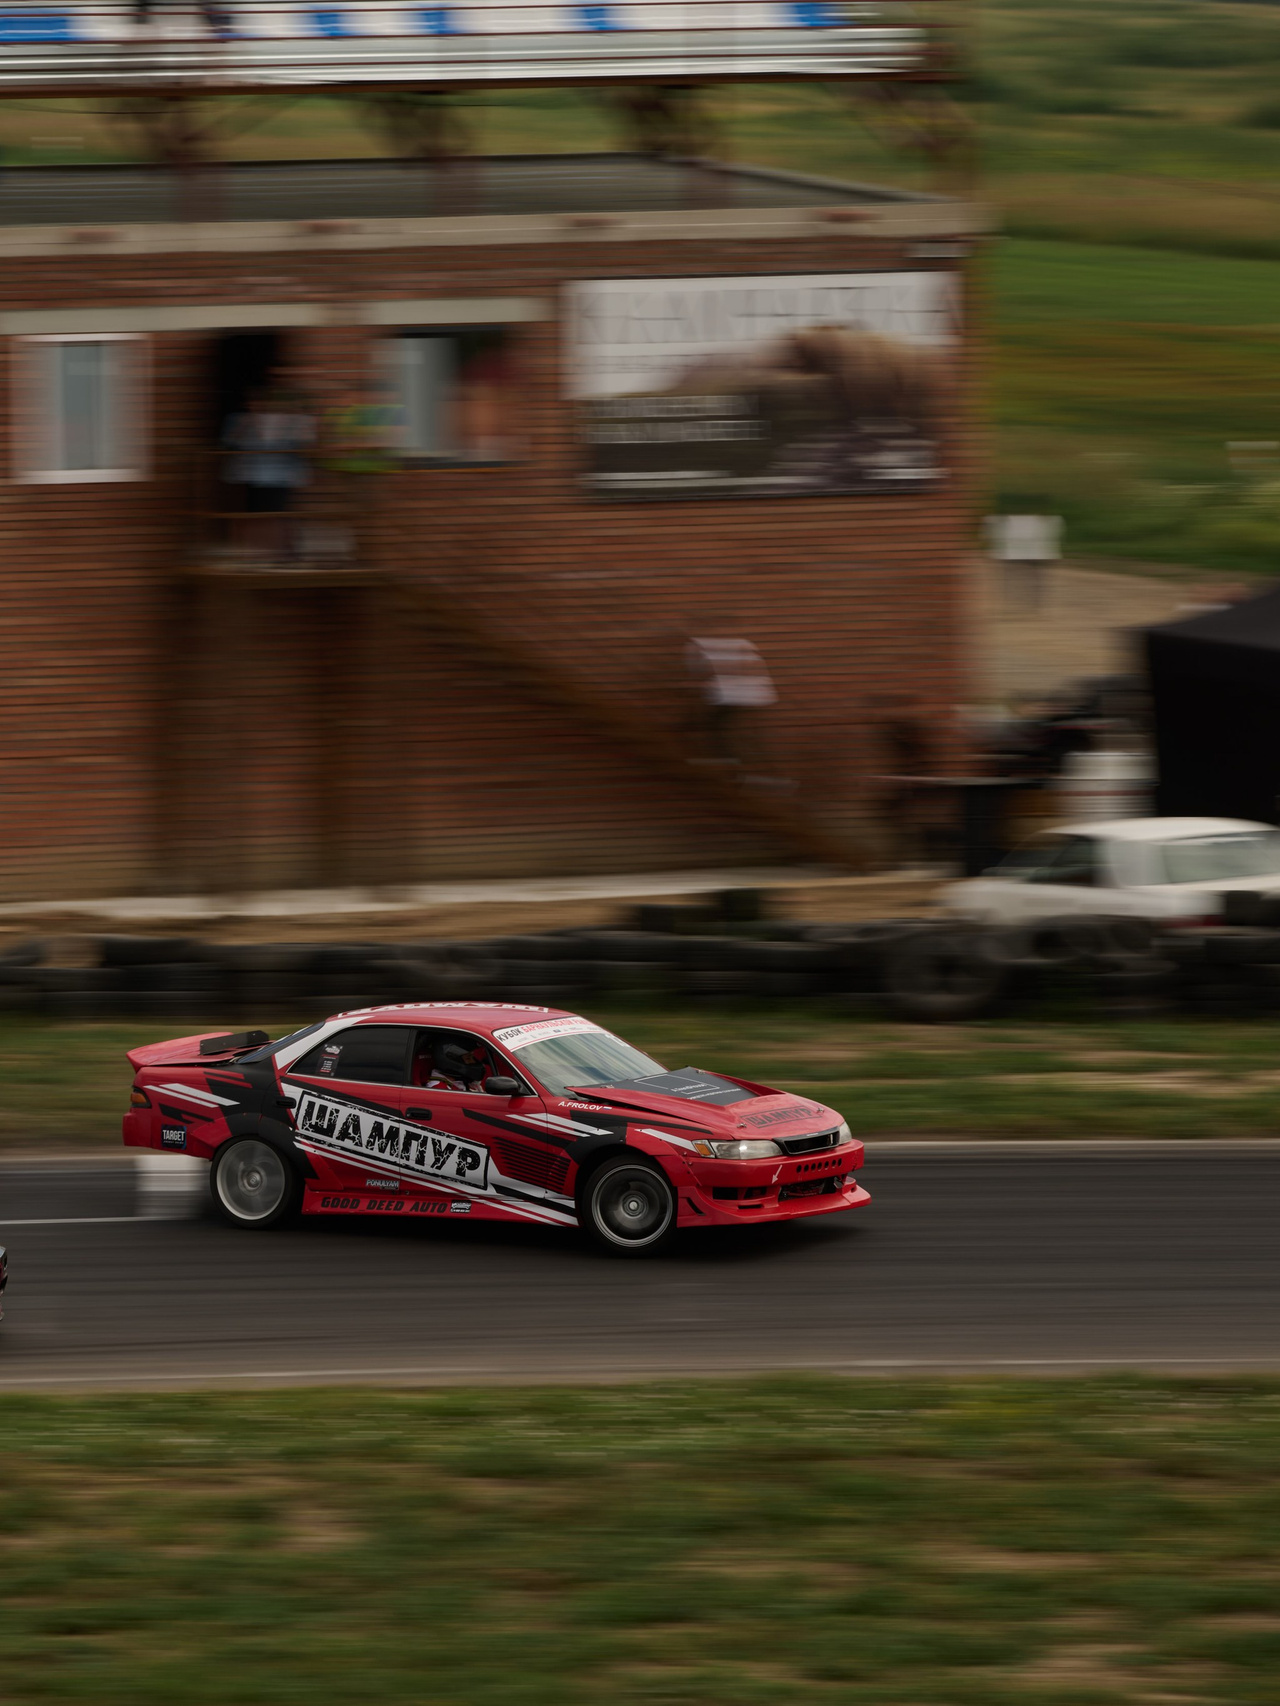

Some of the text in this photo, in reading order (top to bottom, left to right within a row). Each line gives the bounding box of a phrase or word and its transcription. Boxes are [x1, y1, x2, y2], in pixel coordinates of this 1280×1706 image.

[496, 1027, 524, 1042] КУБОК
[558, 1100, 605, 1112] A.FROLOV
[746, 1108, 812, 1126] ШАМПУР
[162, 1129, 186, 1142] TARGET
[301, 1100, 481, 1178] ШАМПУР
